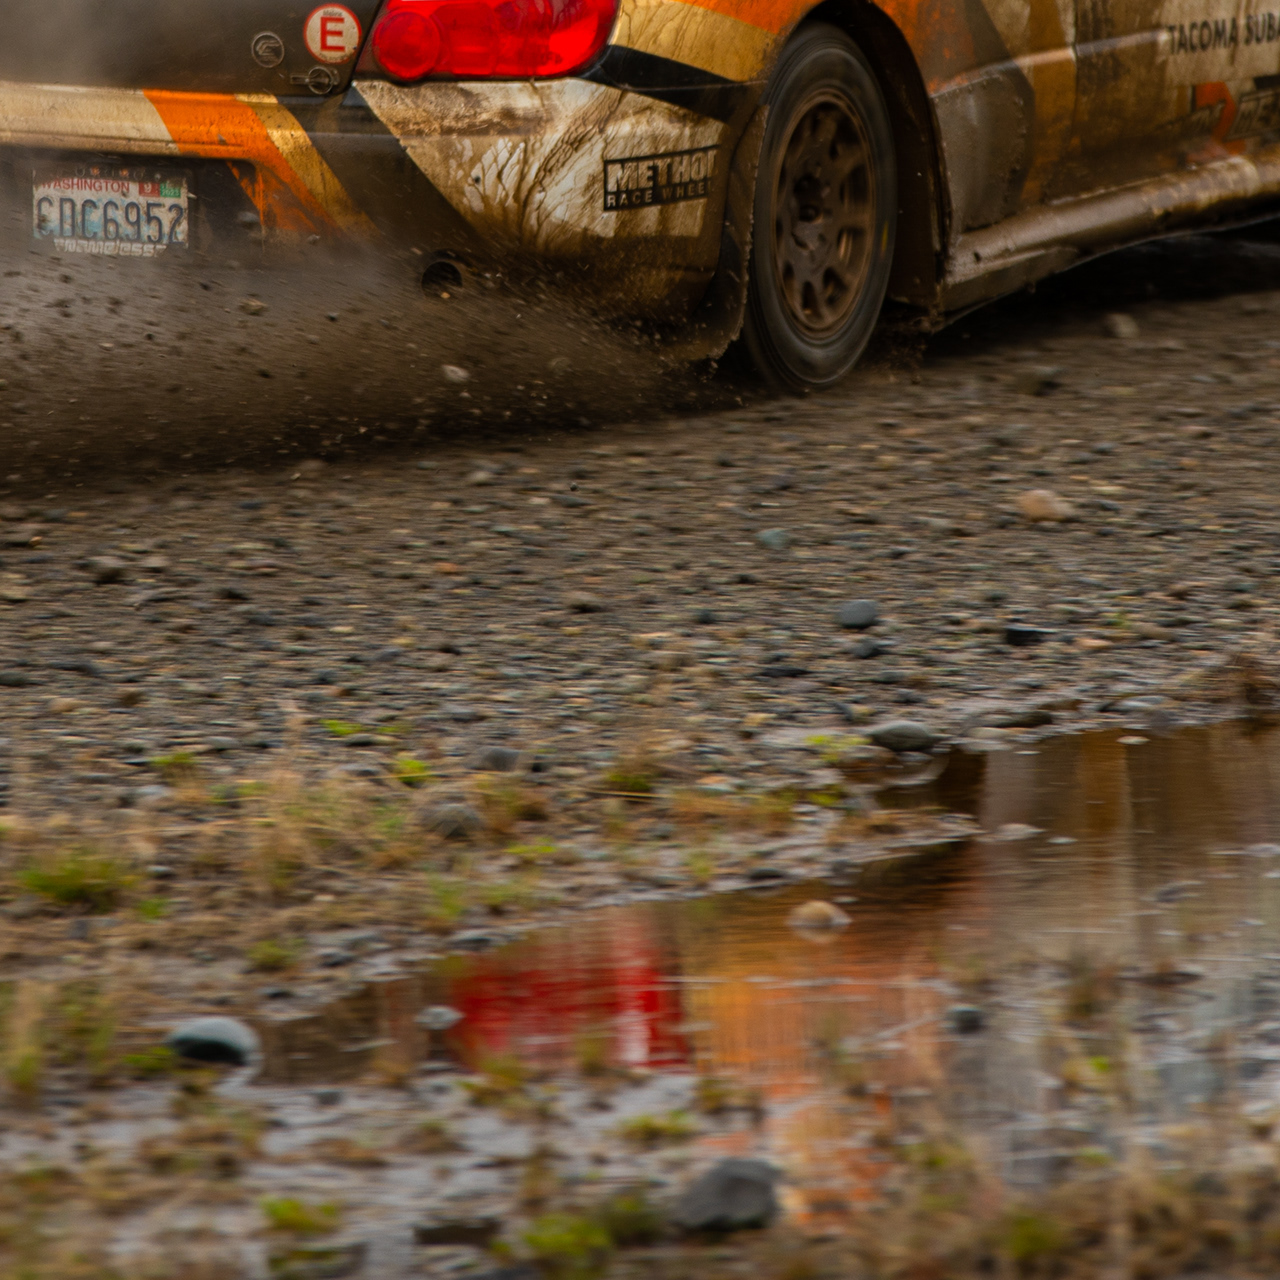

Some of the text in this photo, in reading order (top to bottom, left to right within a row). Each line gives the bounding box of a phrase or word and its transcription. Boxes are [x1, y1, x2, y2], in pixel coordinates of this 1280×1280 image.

[320, 16, 345, 53] E
[1166, 16, 1239, 56] TACOMA
[40, 176, 131, 194] WASHINGTON
[607, 190, 653, 208] RACE
